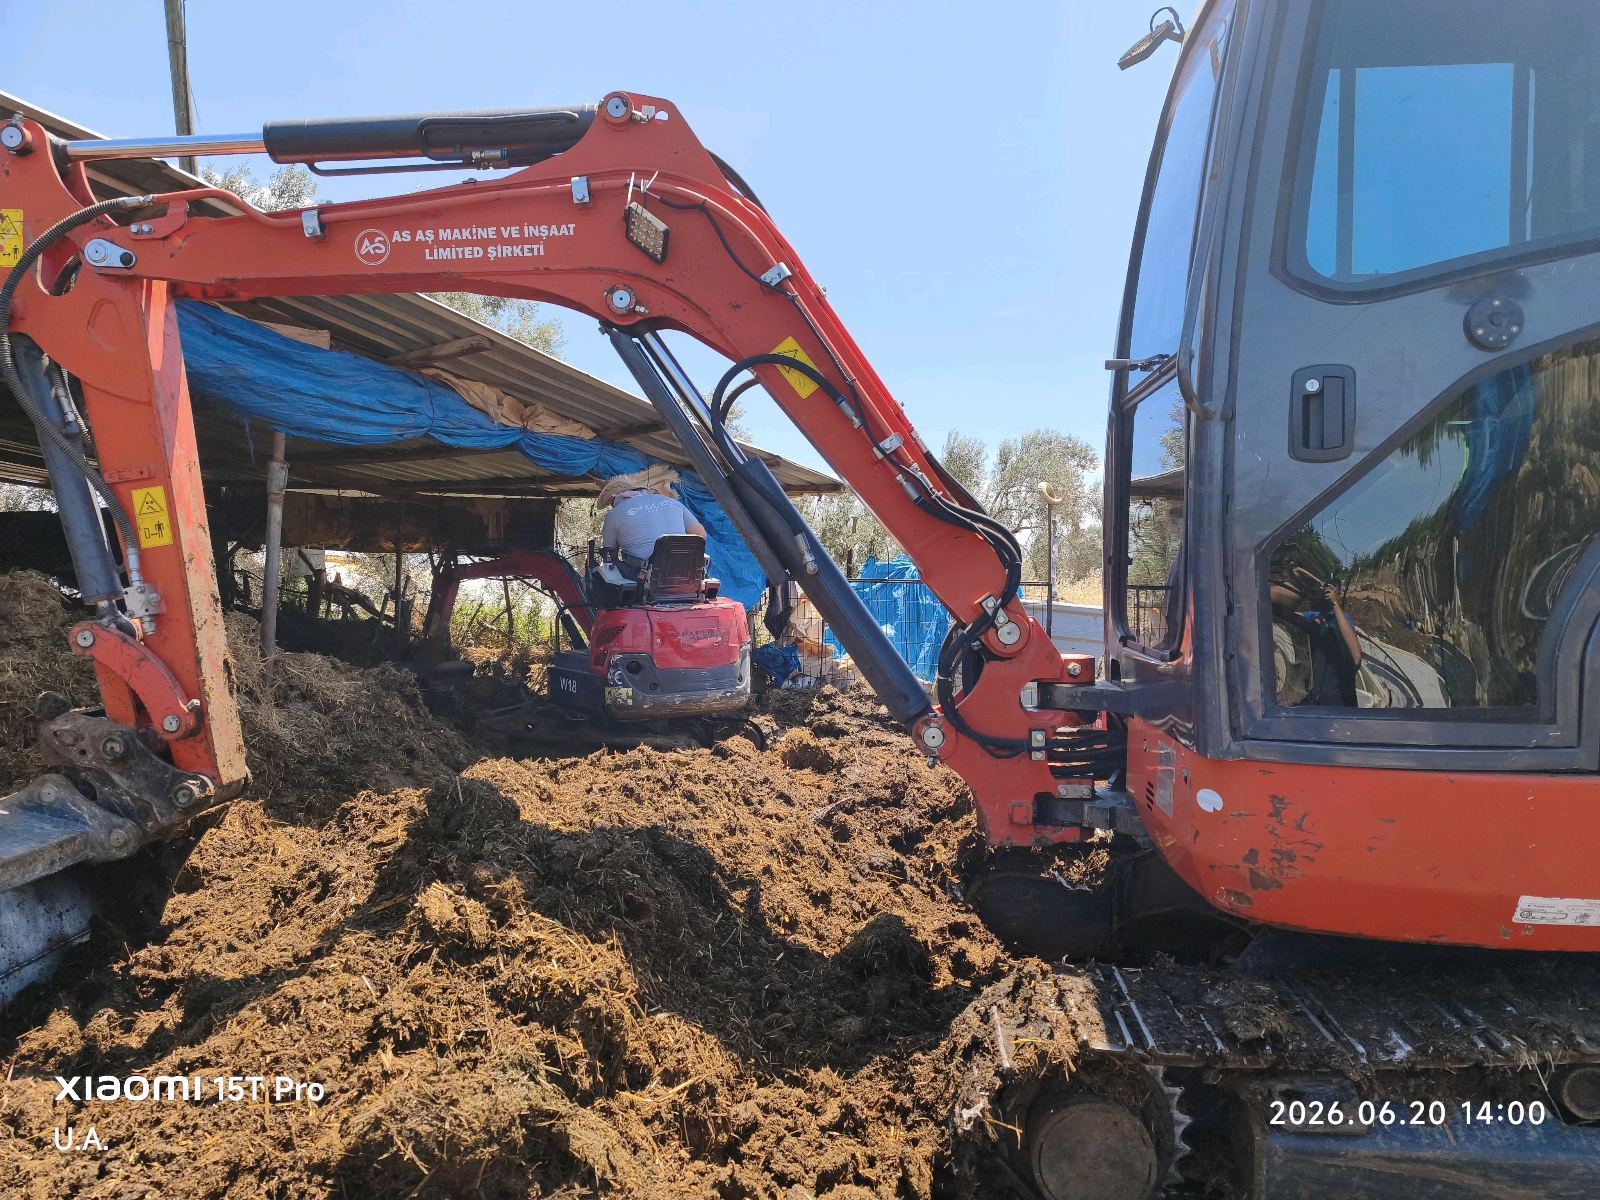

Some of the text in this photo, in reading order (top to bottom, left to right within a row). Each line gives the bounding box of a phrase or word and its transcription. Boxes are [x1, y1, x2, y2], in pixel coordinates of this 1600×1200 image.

[391, 222, 576, 245] AS AŞ MAKİNE VE İNŞAAT
[360, 236, 386, 255] AS
[424, 241, 545, 261] LİMİTED ŞİRKETİ
